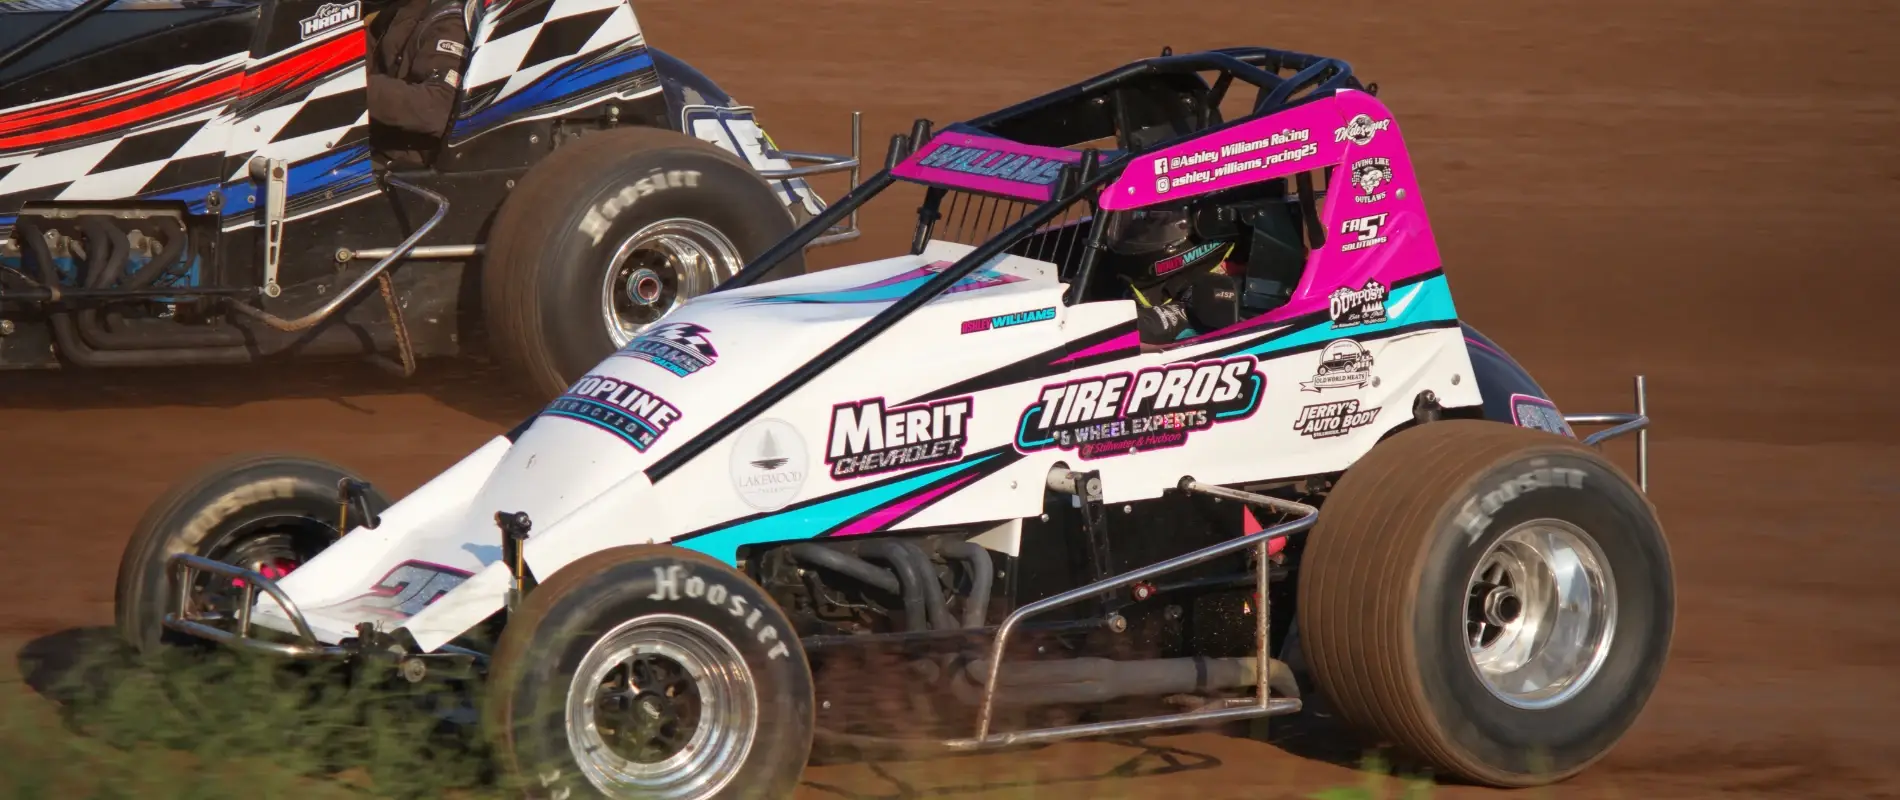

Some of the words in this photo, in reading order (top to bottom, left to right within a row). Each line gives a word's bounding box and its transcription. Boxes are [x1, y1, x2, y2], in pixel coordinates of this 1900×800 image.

[918, 143, 1064, 186] WILLIAMS
[1170, 151, 1219, 170] @Ashley
[1221, 136, 1269, 158] Williams
[1270, 129, 1309, 146] Racing
[1172, 143, 1318, 188] ashley_williams_racing25
[1352, 158, 1373, 170] LIVING
[1374, 157, 1390, 166] LIKE
[1355, 191, 1387, 203] OUTLAWS
[992, 307, 1056, 329] WILLIAMS
[1330, 285, 1385, 320] OUTPOST
[1327, 375, 1346, 383] WORLD
[1347, 373, 1365, 381] MEATS
[1038, 376, 1128, 430] TIRE
[1294, 400, 1358, 429] JERRY'S
[1060, 430, 1070, 445] &
[1074, 421, 1129, 443] WHEEL
[1132, 410, 1207, 434] EXPERTS
[1303, 416, 1340, 433] AUTO
[1342, 409, 1378, 427] BODY
[739, 471, 802, 488] LAKEWOOD
[647, 565, 790, 661] Hoosier
